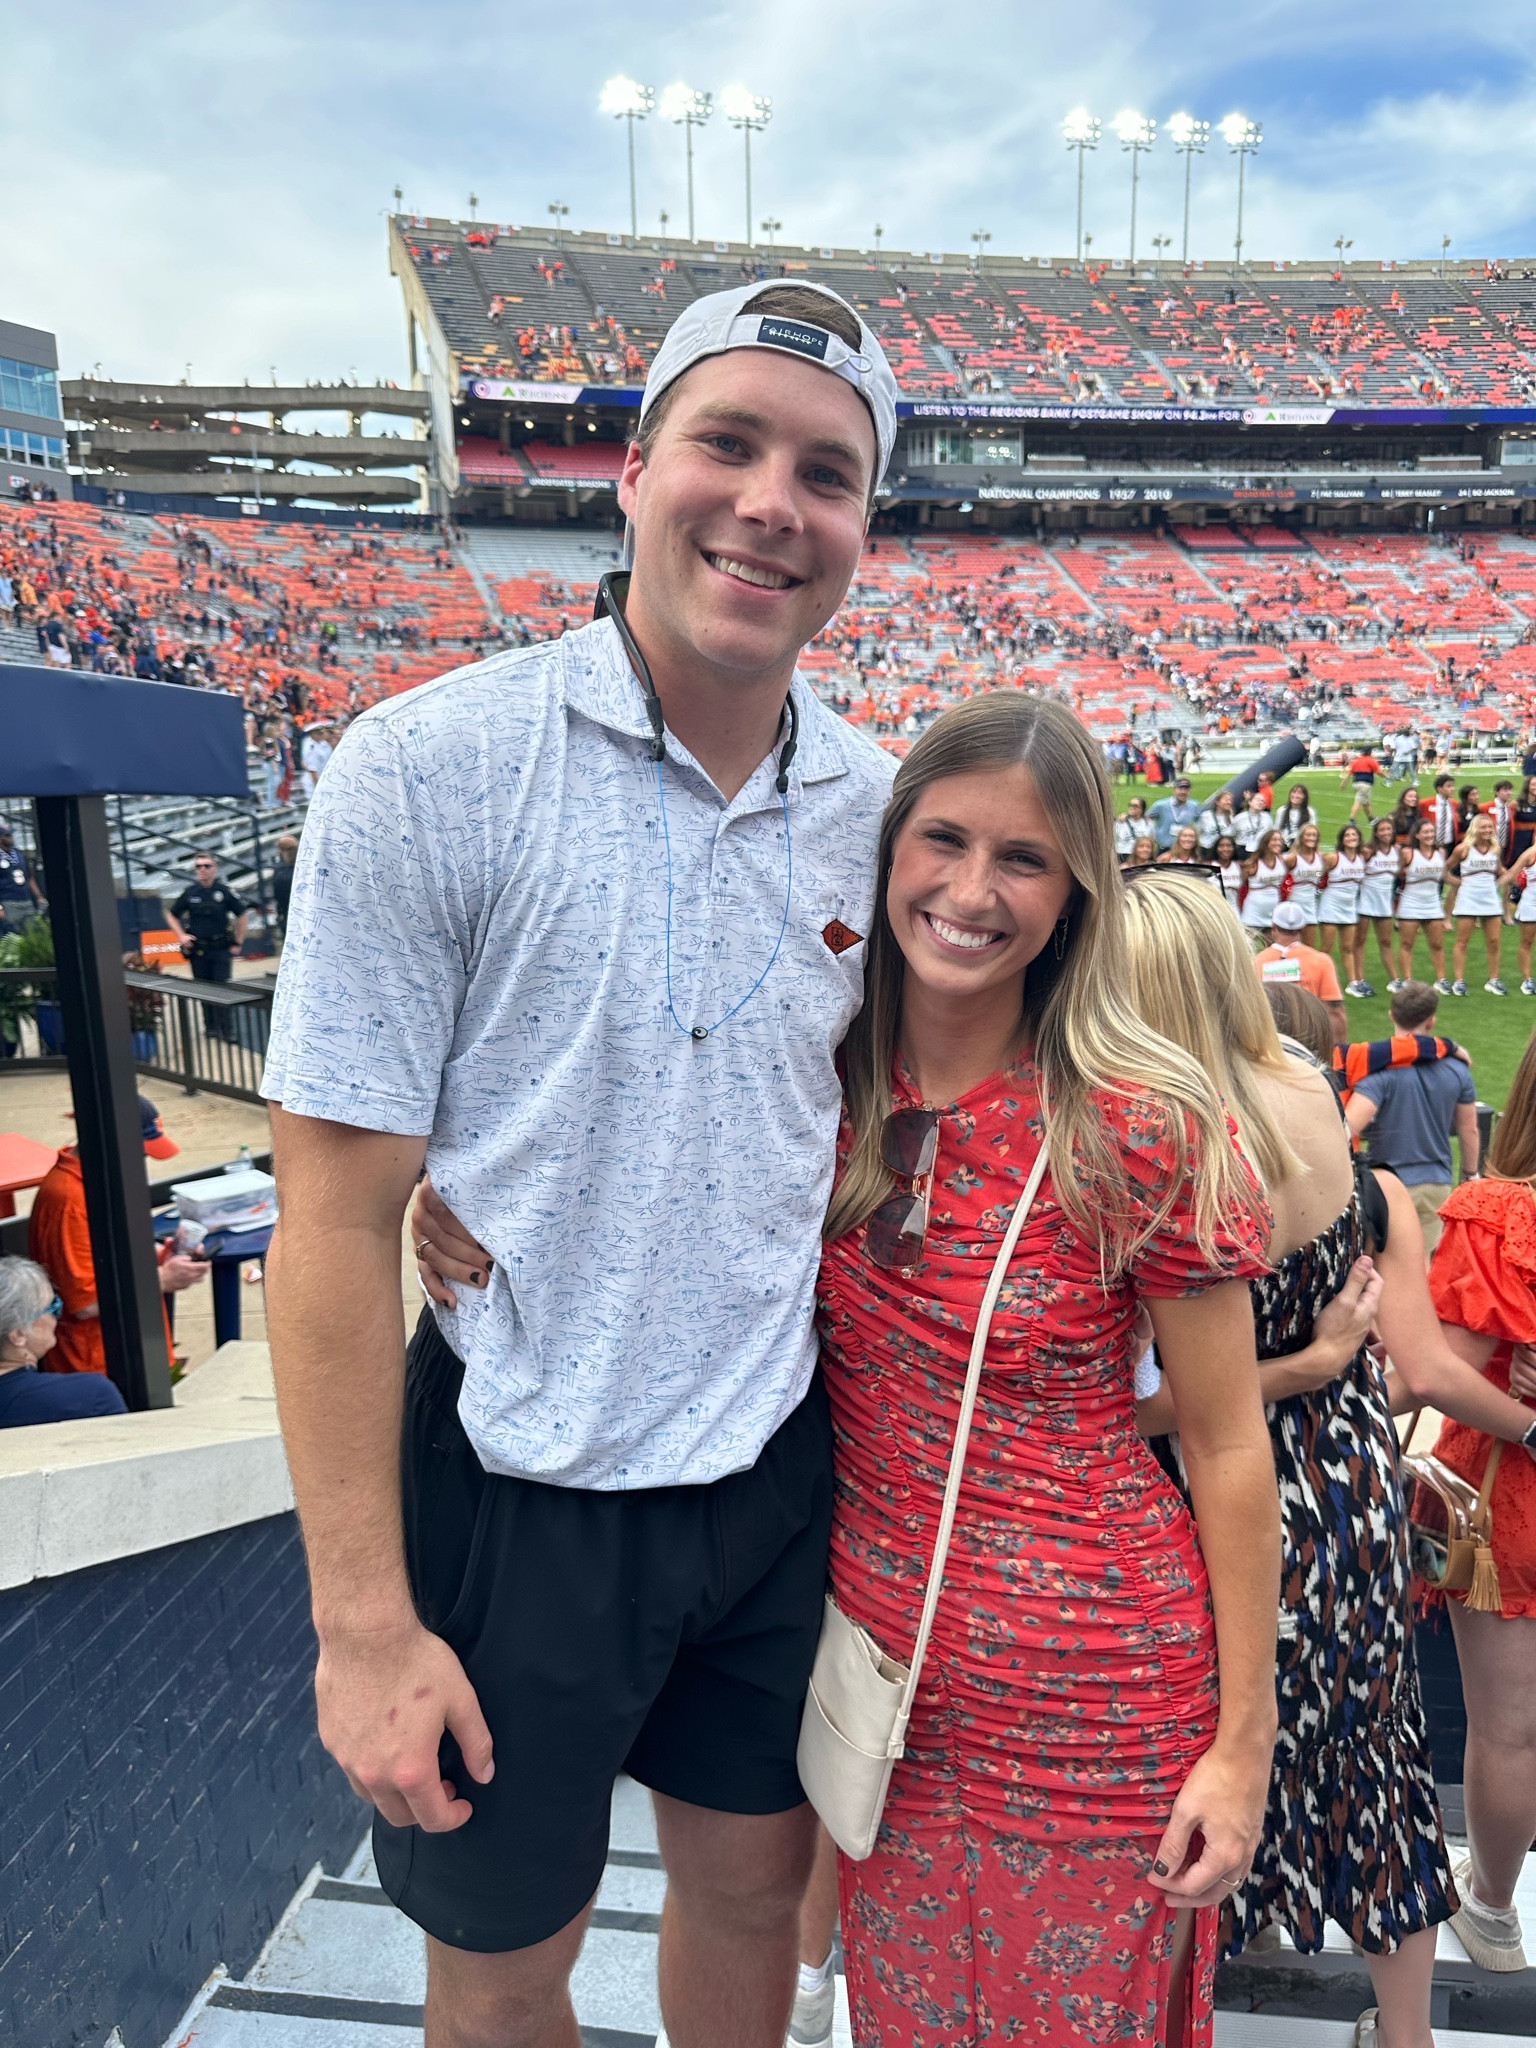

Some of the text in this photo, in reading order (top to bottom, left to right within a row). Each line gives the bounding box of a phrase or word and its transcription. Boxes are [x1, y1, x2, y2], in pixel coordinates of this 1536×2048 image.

[762, 325, 823, 346] FAIRHOPE
[913, 404, 951, 416] LISTEN
[951, 405, 967, 417] TO
[967, 406, 989, 417] THE
[1130, 409, 1164, 420] SHOW
[1164, 409, 1182, 421] ON
[978, 487, 1173, 501] NATIONAL CHAMPIONS 1957 2010
